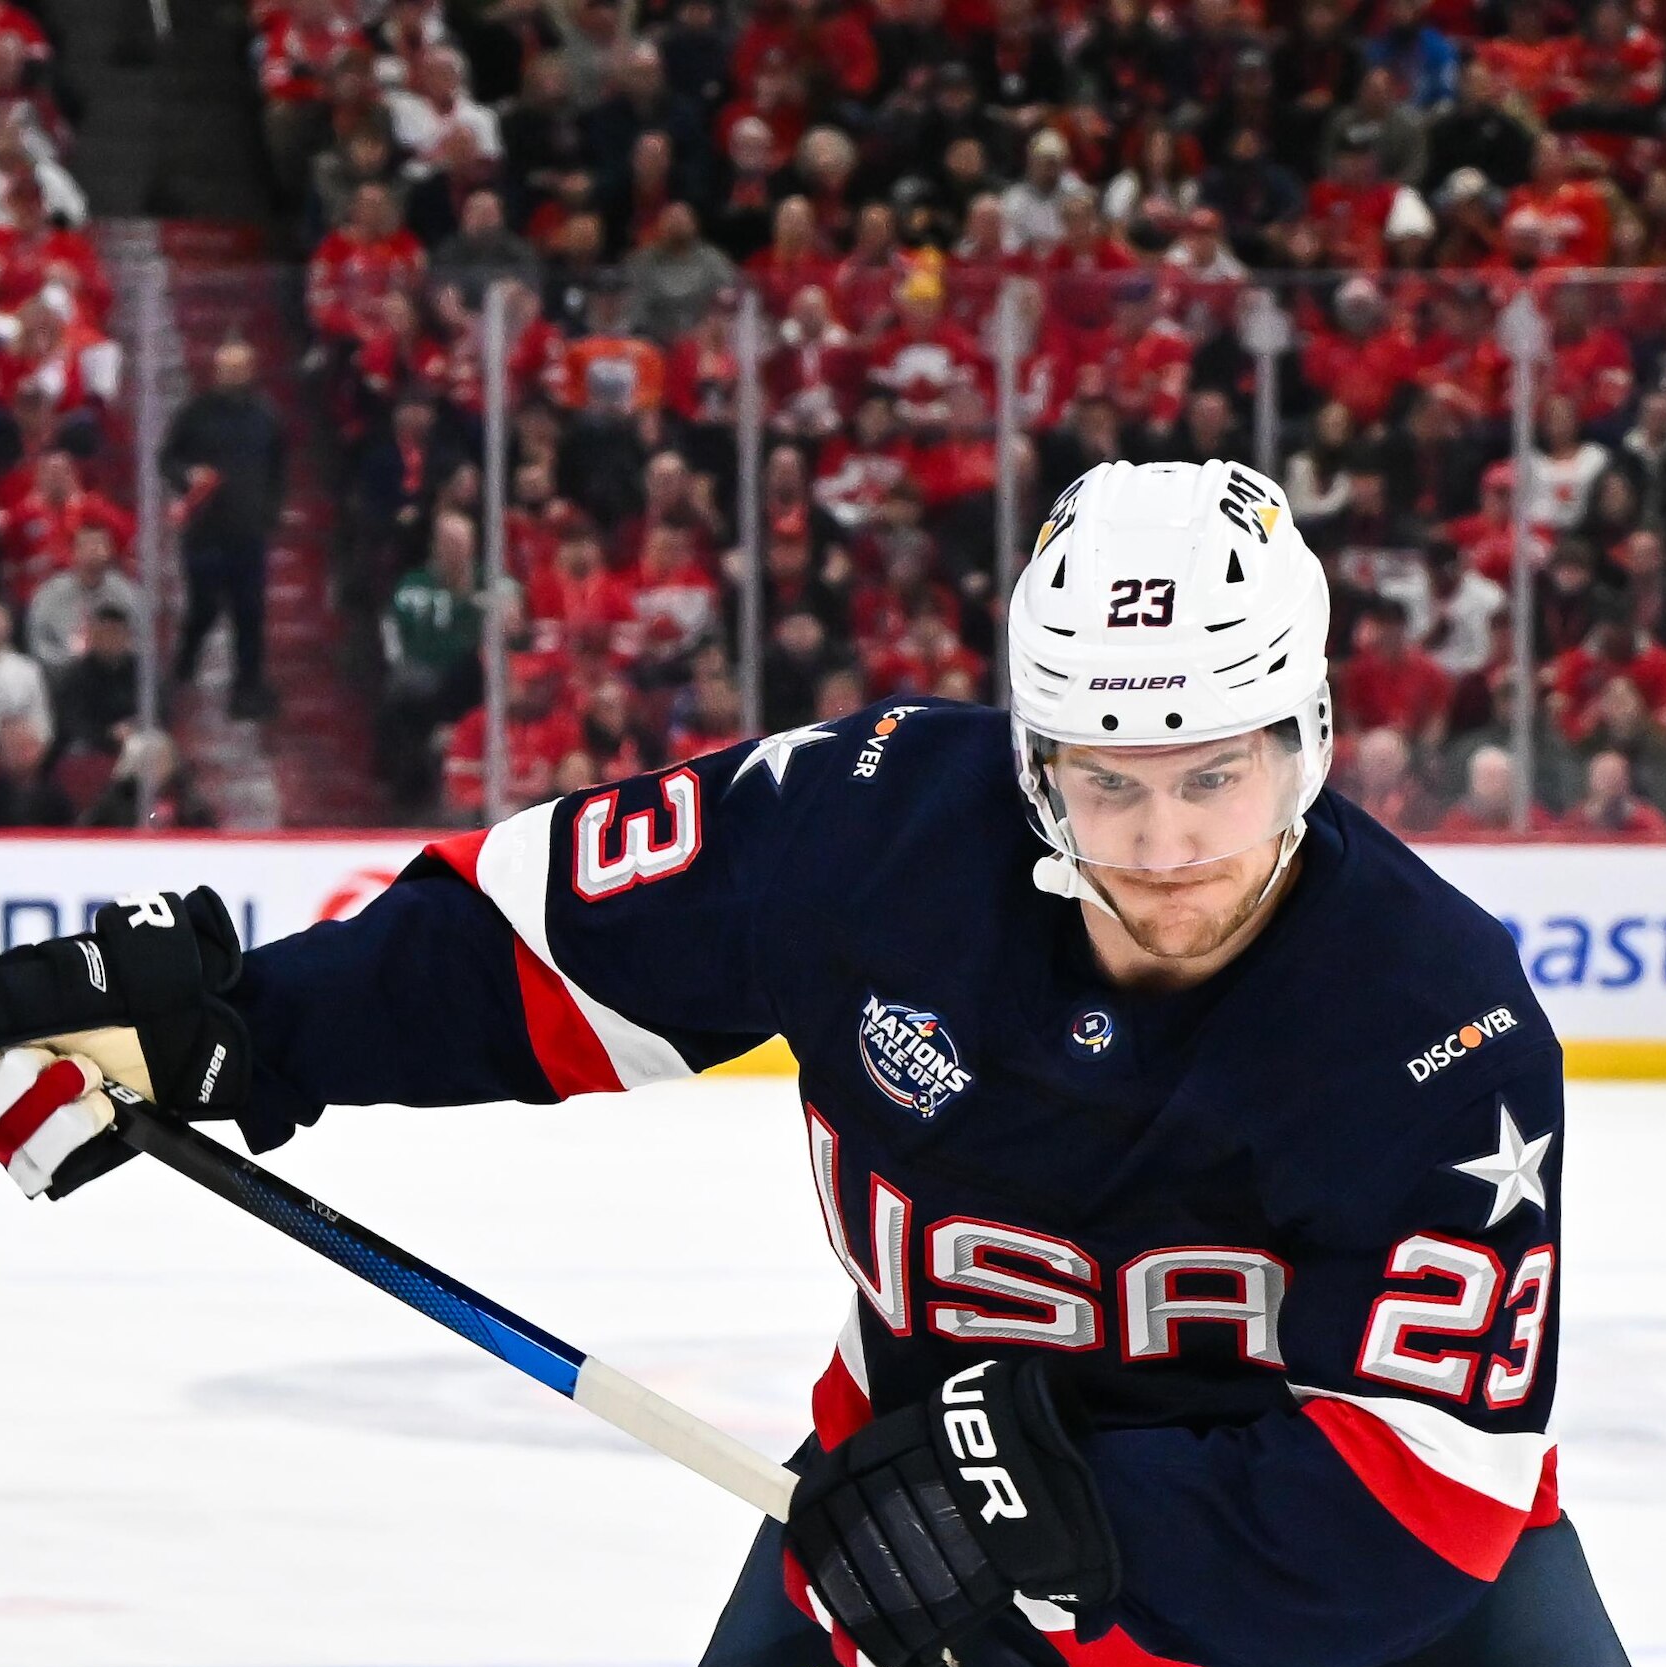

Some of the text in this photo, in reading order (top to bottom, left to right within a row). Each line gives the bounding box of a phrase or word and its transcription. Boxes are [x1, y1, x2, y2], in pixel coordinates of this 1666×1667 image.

[1107, 578, 1176, 628] 23
[1088, 674, 1187, 691] BAUER
[853, 706, 929, 778] COVER
[572, 767, 702, 903] 3
[198, 1042, 227, 1105] BAUER
[863, 995, 973, 1093] NATIONS
[877, 1057, 902, 1081] 2025
[1407, 1007, 1518, 1083] DISCOVER
[806, 1102, 1293, 1371] USA
[1353, 1229, 1556, 1411] 23
